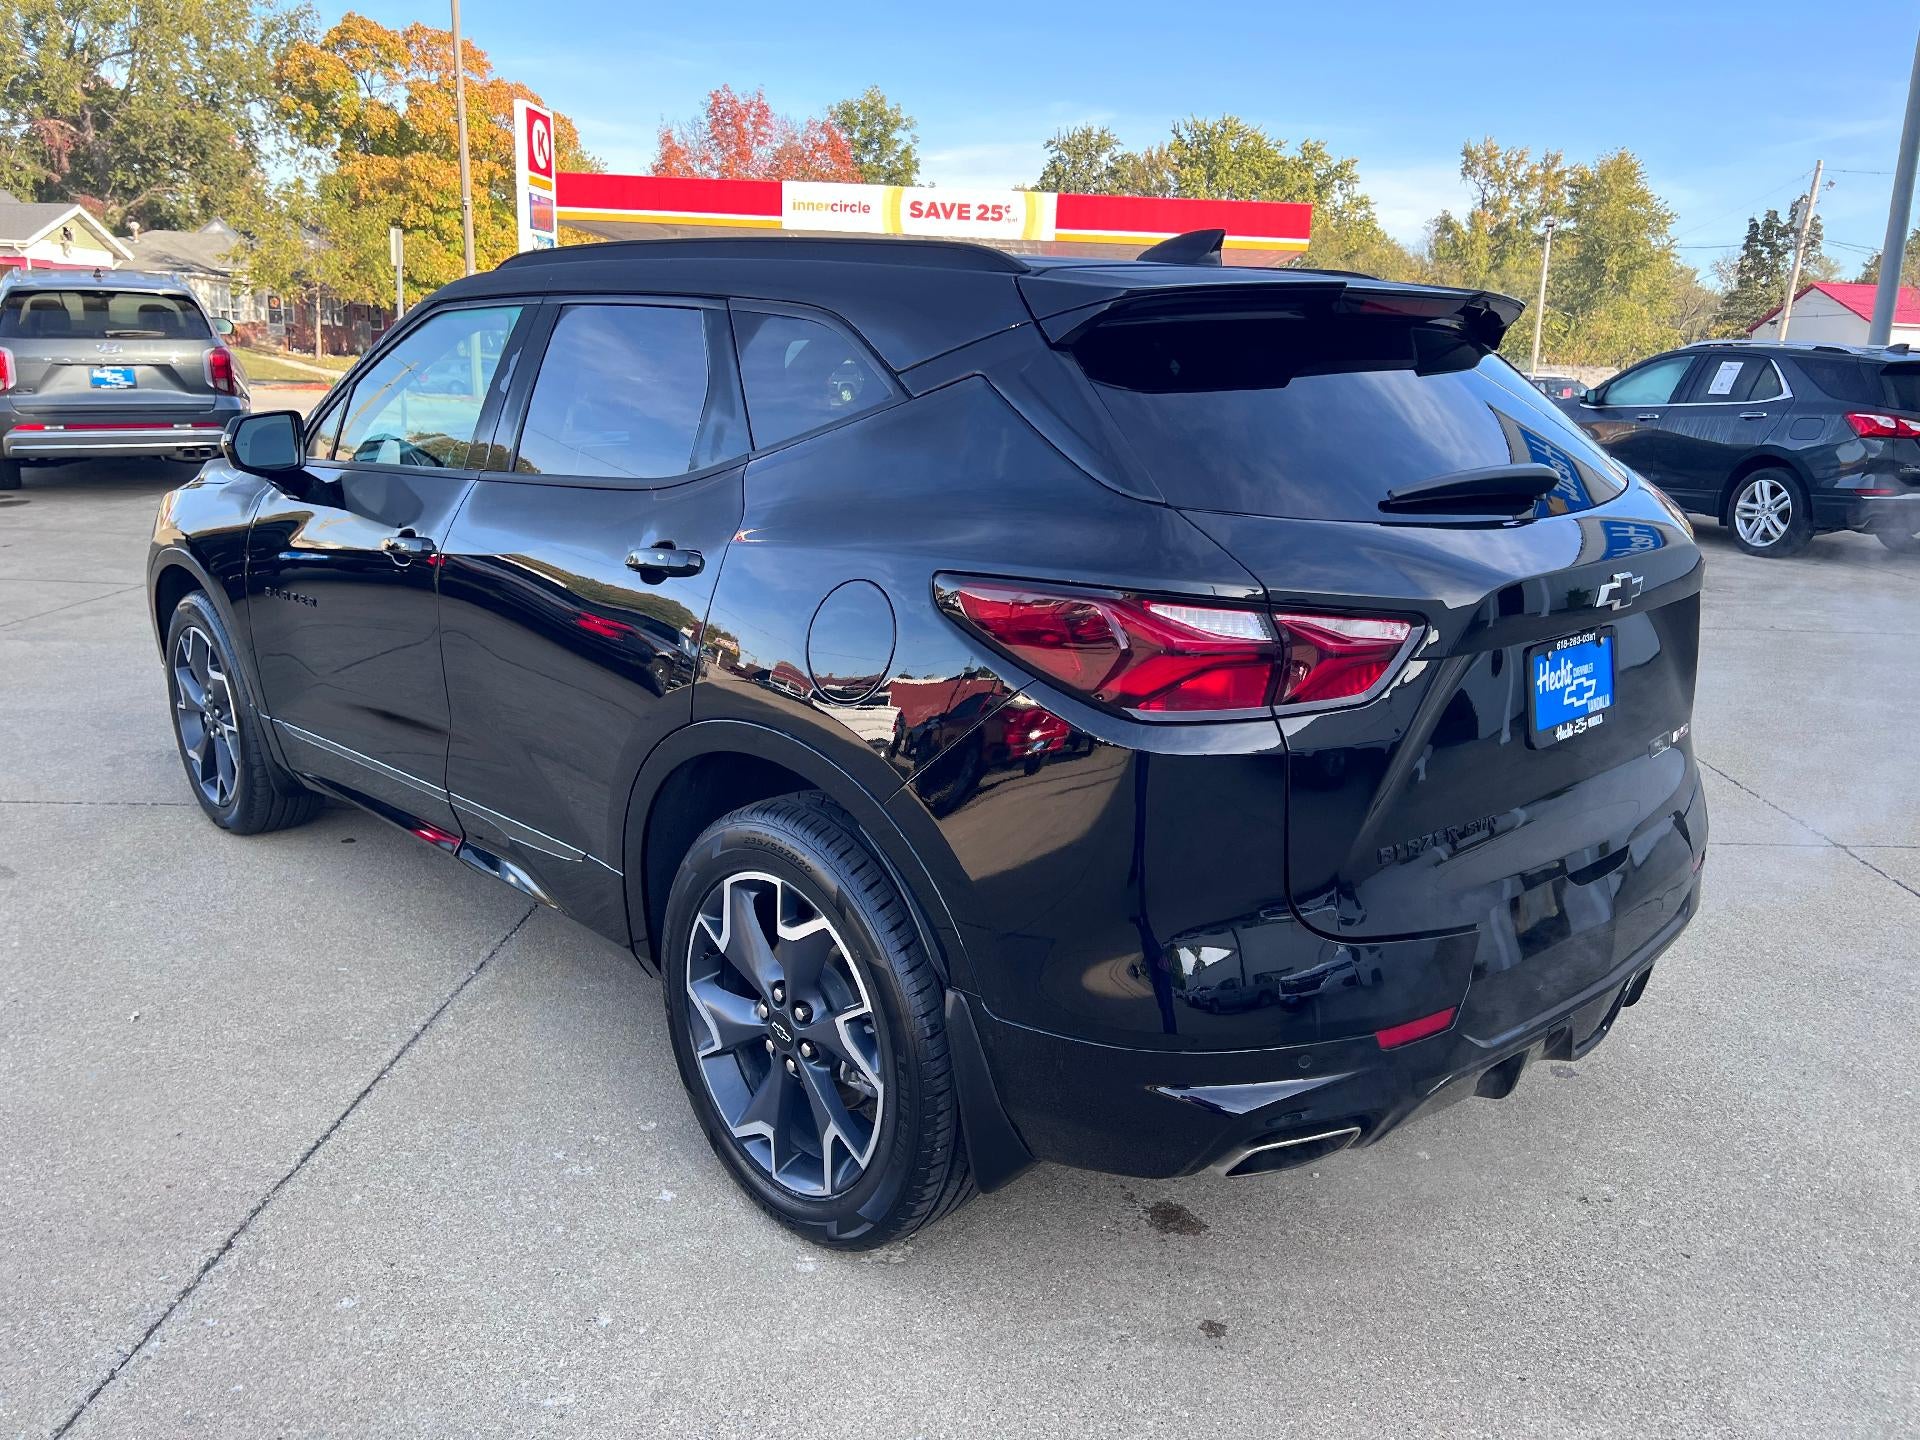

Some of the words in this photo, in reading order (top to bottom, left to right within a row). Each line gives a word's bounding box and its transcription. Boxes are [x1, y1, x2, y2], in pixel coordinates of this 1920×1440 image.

[537, 129, 549, 162] K
[792, 198, 871, 214] innercircle
[909, 200, 971, 221] SAVE
[1536, 656, 1573, 695] Hecht
